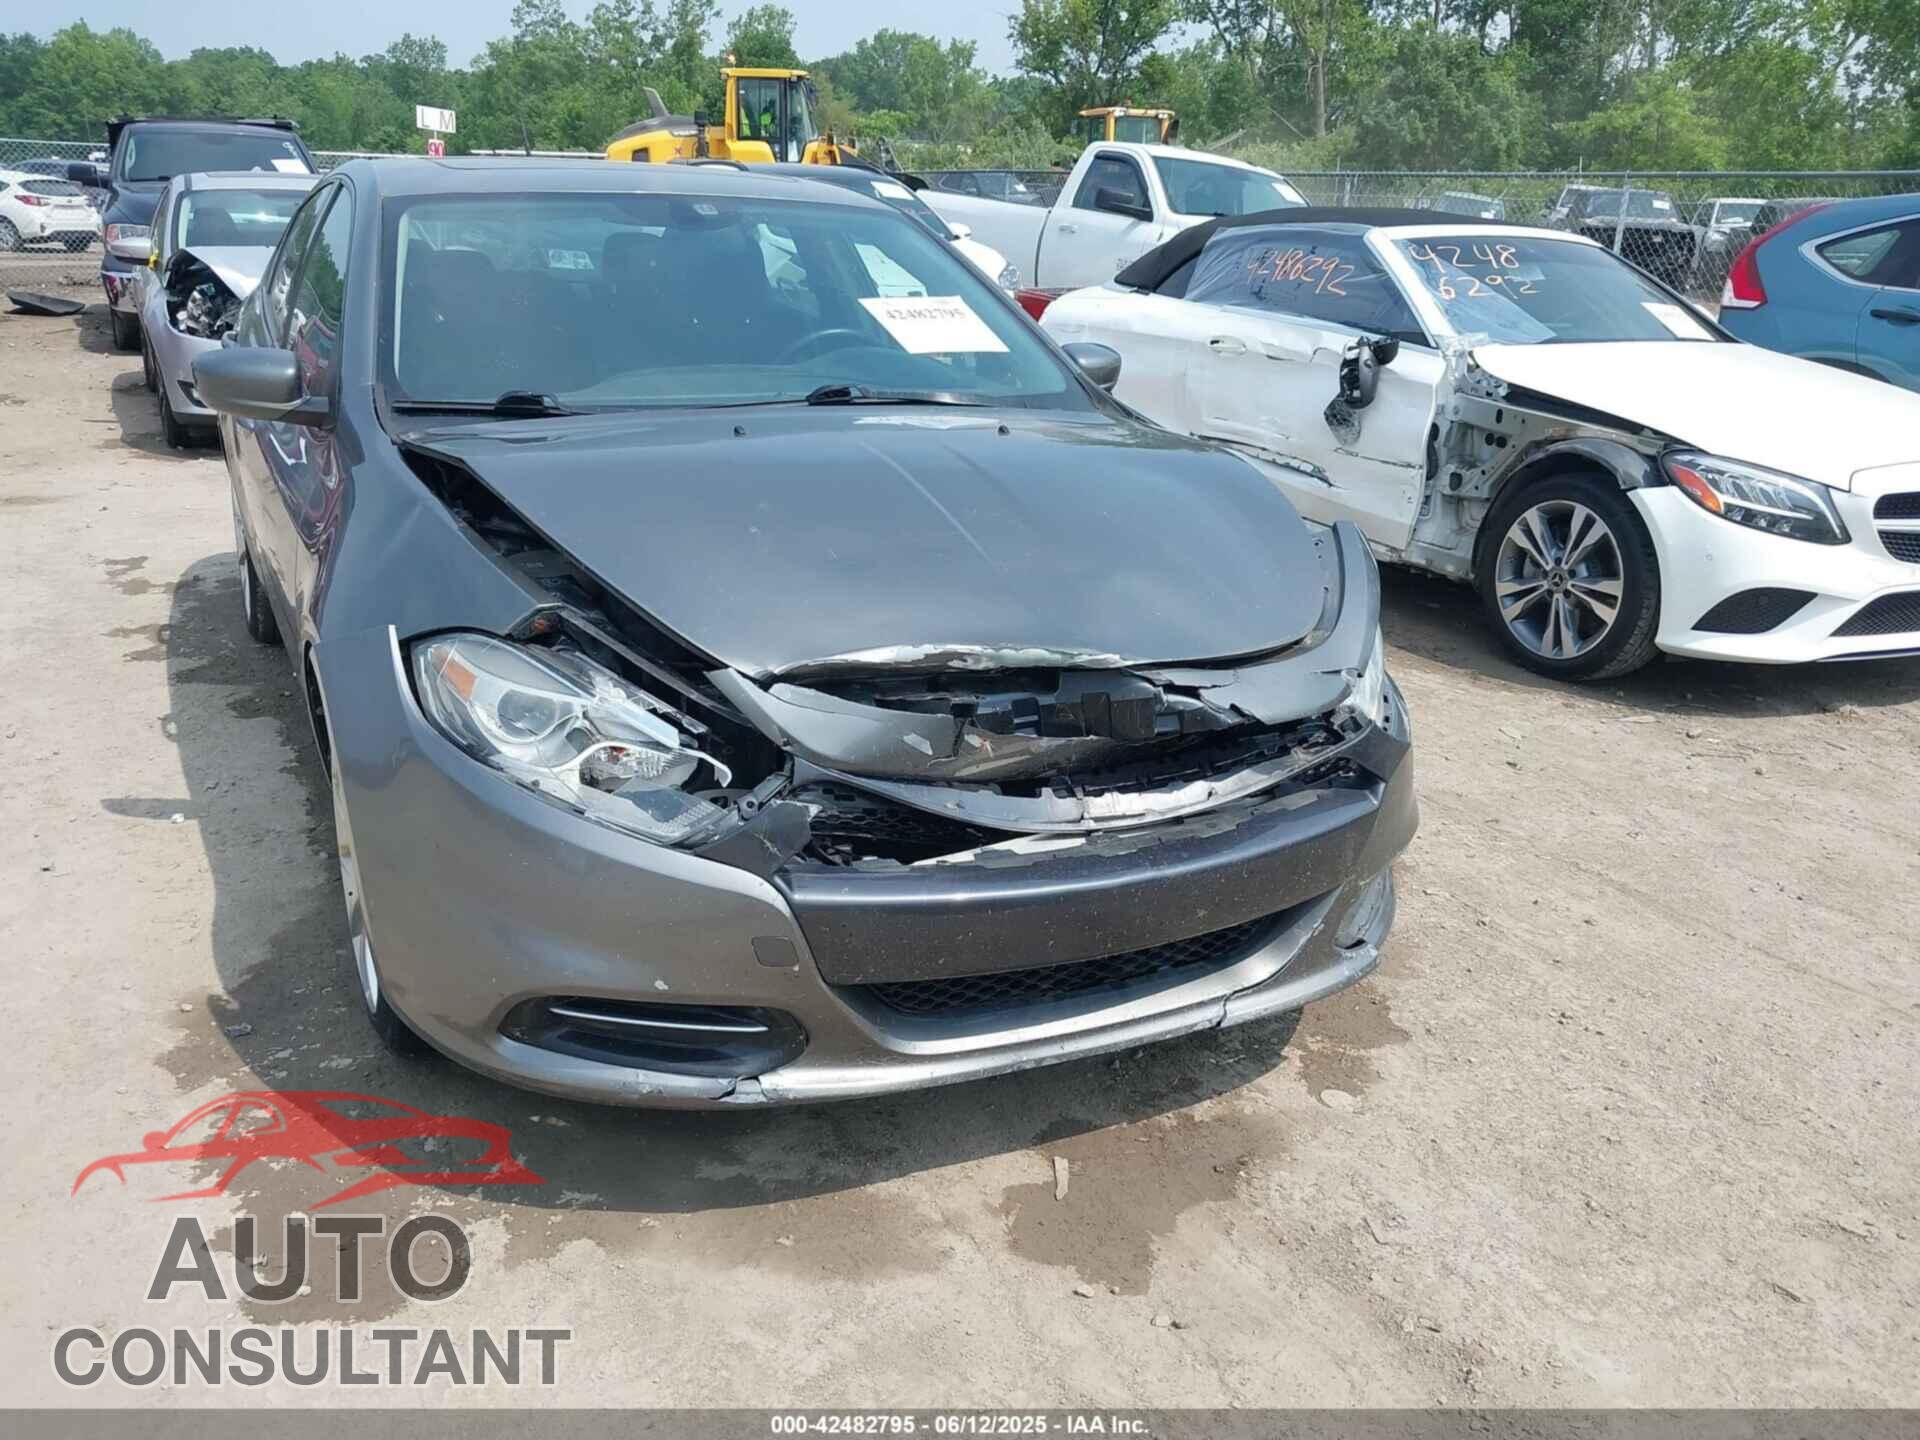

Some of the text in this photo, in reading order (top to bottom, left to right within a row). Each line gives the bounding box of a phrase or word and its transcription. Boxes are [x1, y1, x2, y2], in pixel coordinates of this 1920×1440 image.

[421, 107, 455, 131] L M
[1408, 243, 1520, 274] 4248
[1439, 275, 1542, 301] 6292
